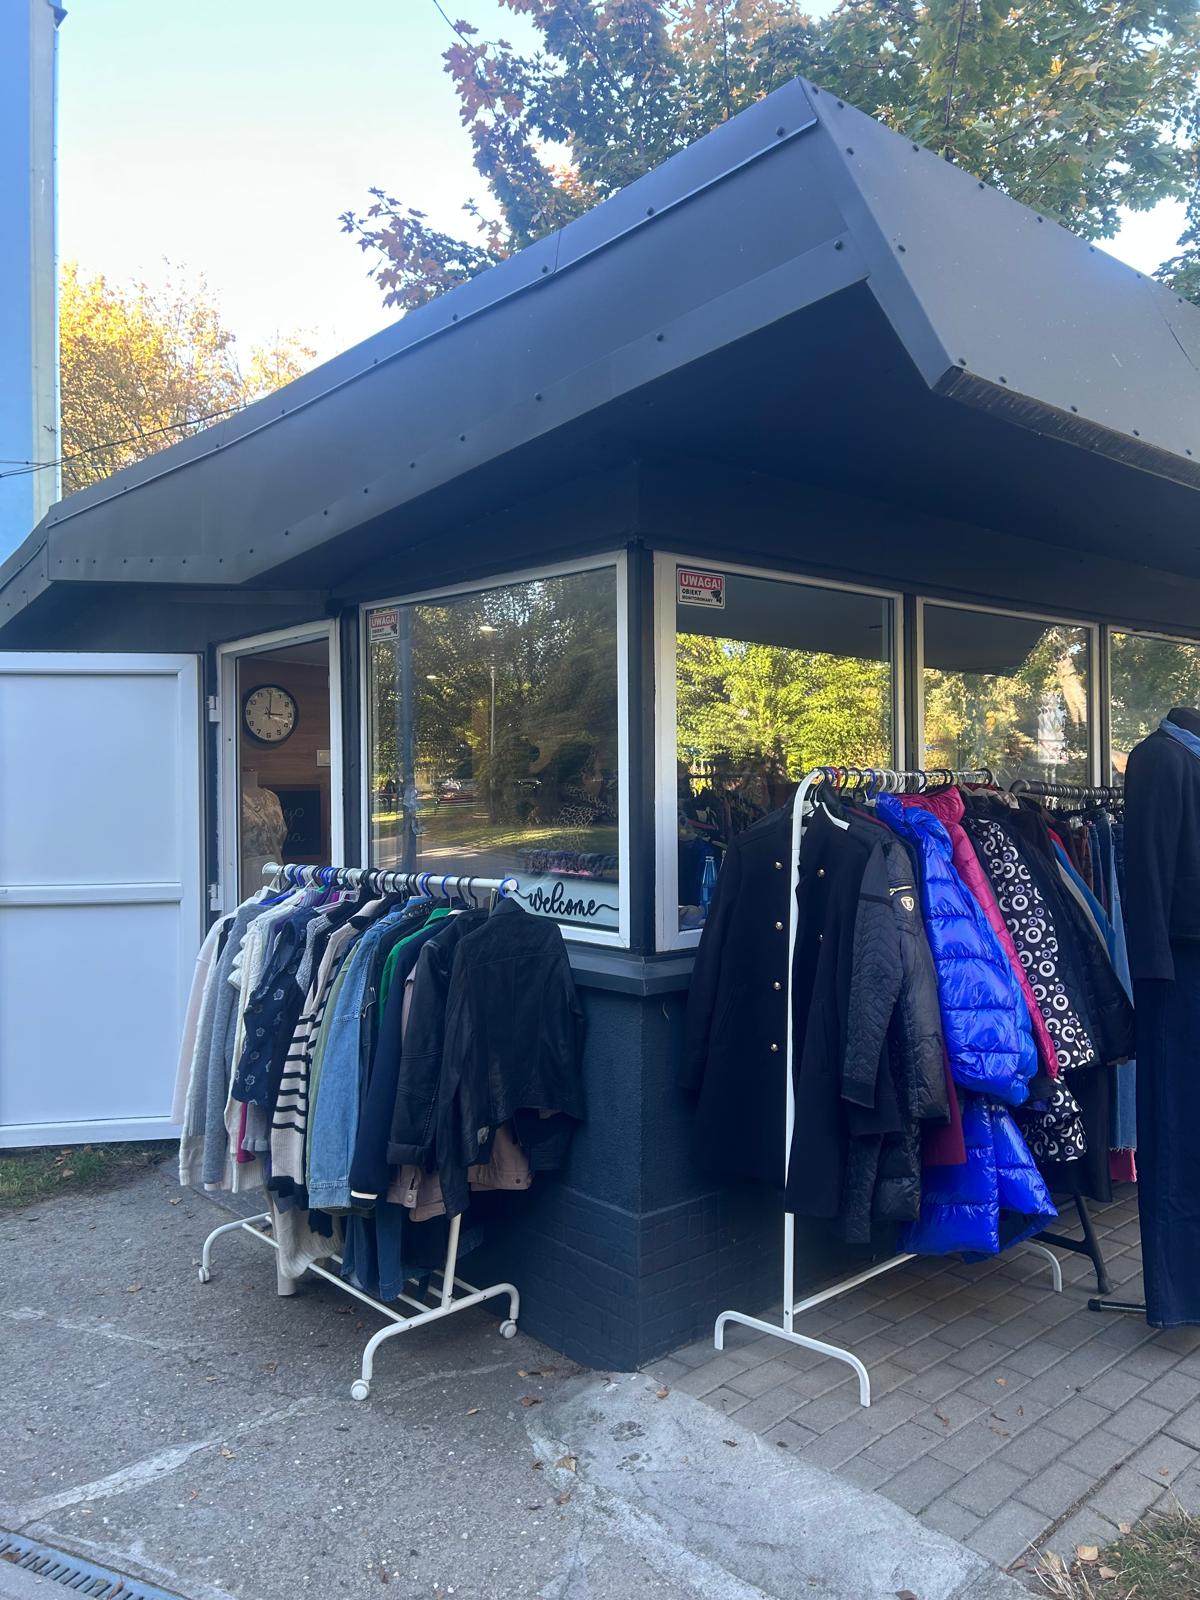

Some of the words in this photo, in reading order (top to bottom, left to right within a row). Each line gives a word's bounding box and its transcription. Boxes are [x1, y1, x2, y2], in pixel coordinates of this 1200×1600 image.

[681, 574, 721, 589] UWAGA!
[371, 615, 397, 627] UWAGA!
[515, 881, 619, 917] welcome
